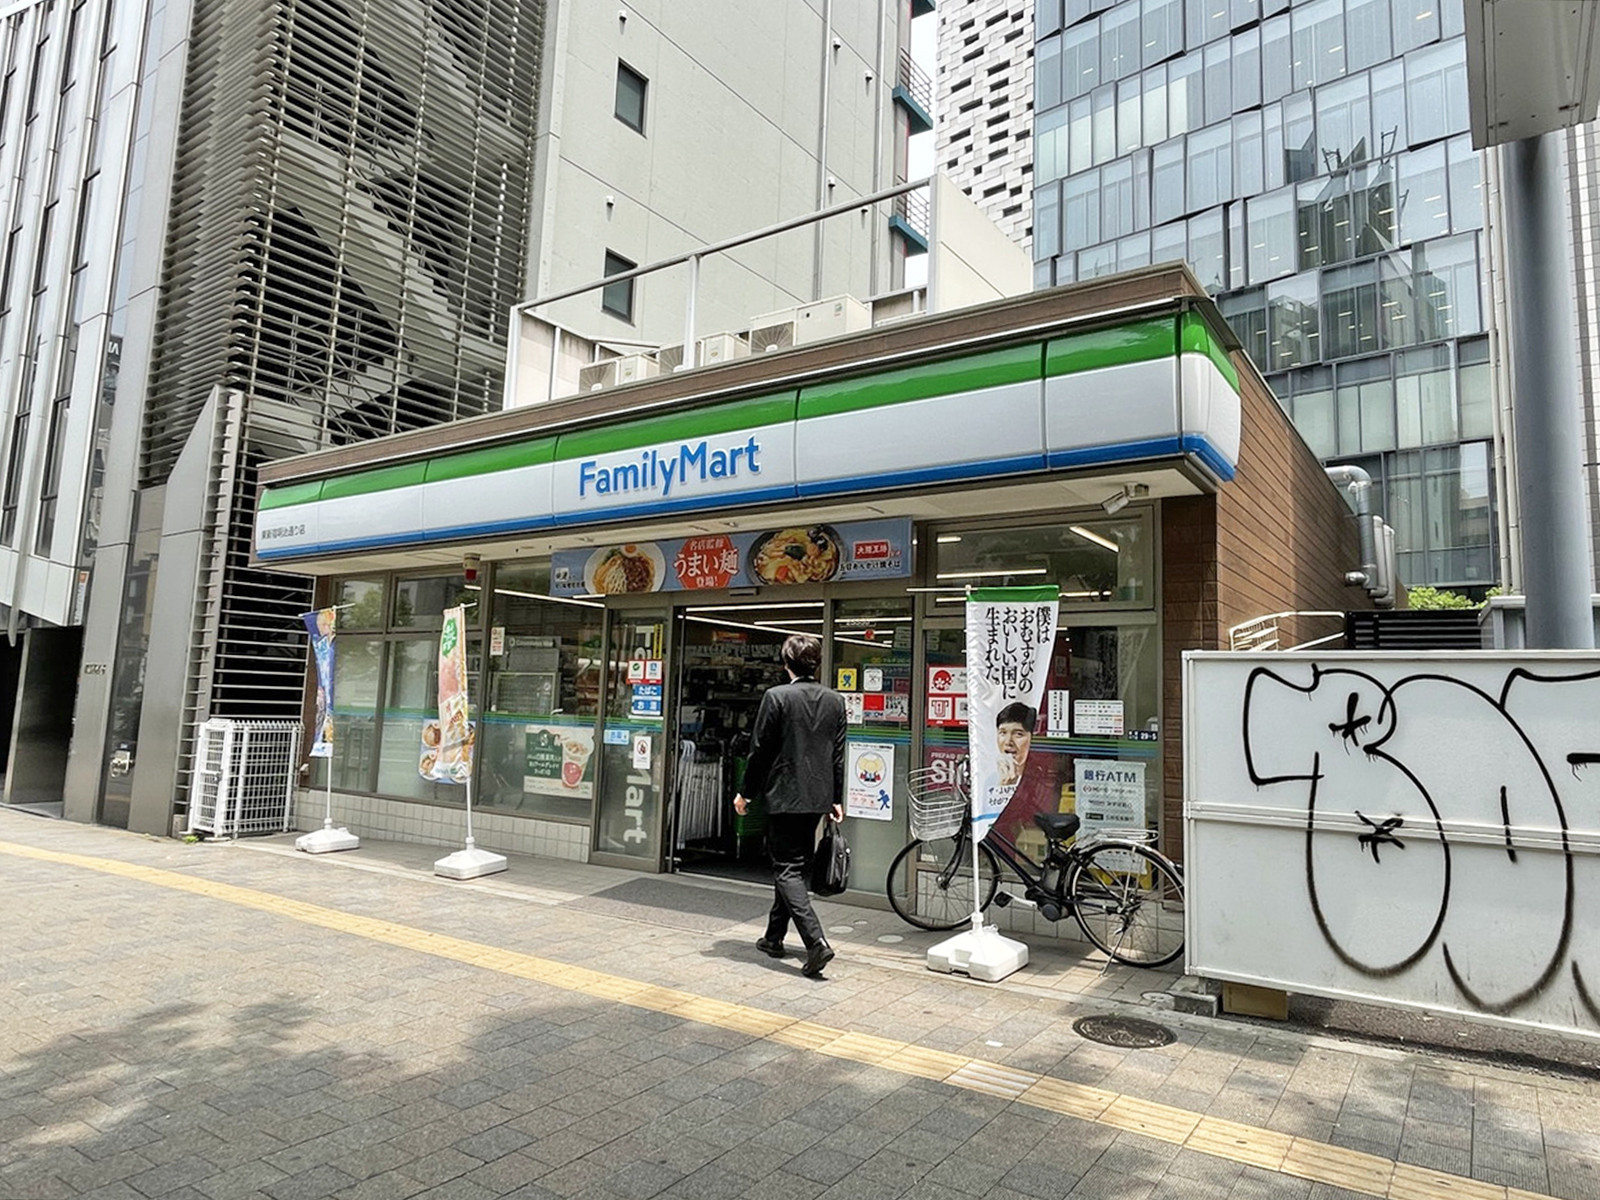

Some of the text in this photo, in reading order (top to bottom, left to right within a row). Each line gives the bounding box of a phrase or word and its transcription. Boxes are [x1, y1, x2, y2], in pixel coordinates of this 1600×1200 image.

[579, 436, 760, 496] FamilyMart
[673, 548, 739, 579] うまい麺
[984, 606, 1001, 685] 生まれた。
[1001, 606, 1018, 700] おいしい国に
[1018, 607, 1035, 694] おむすびの
[1036, 606, 1051, 644] 僕は
[1084, 769, 1136, 783] 銀行ATM
